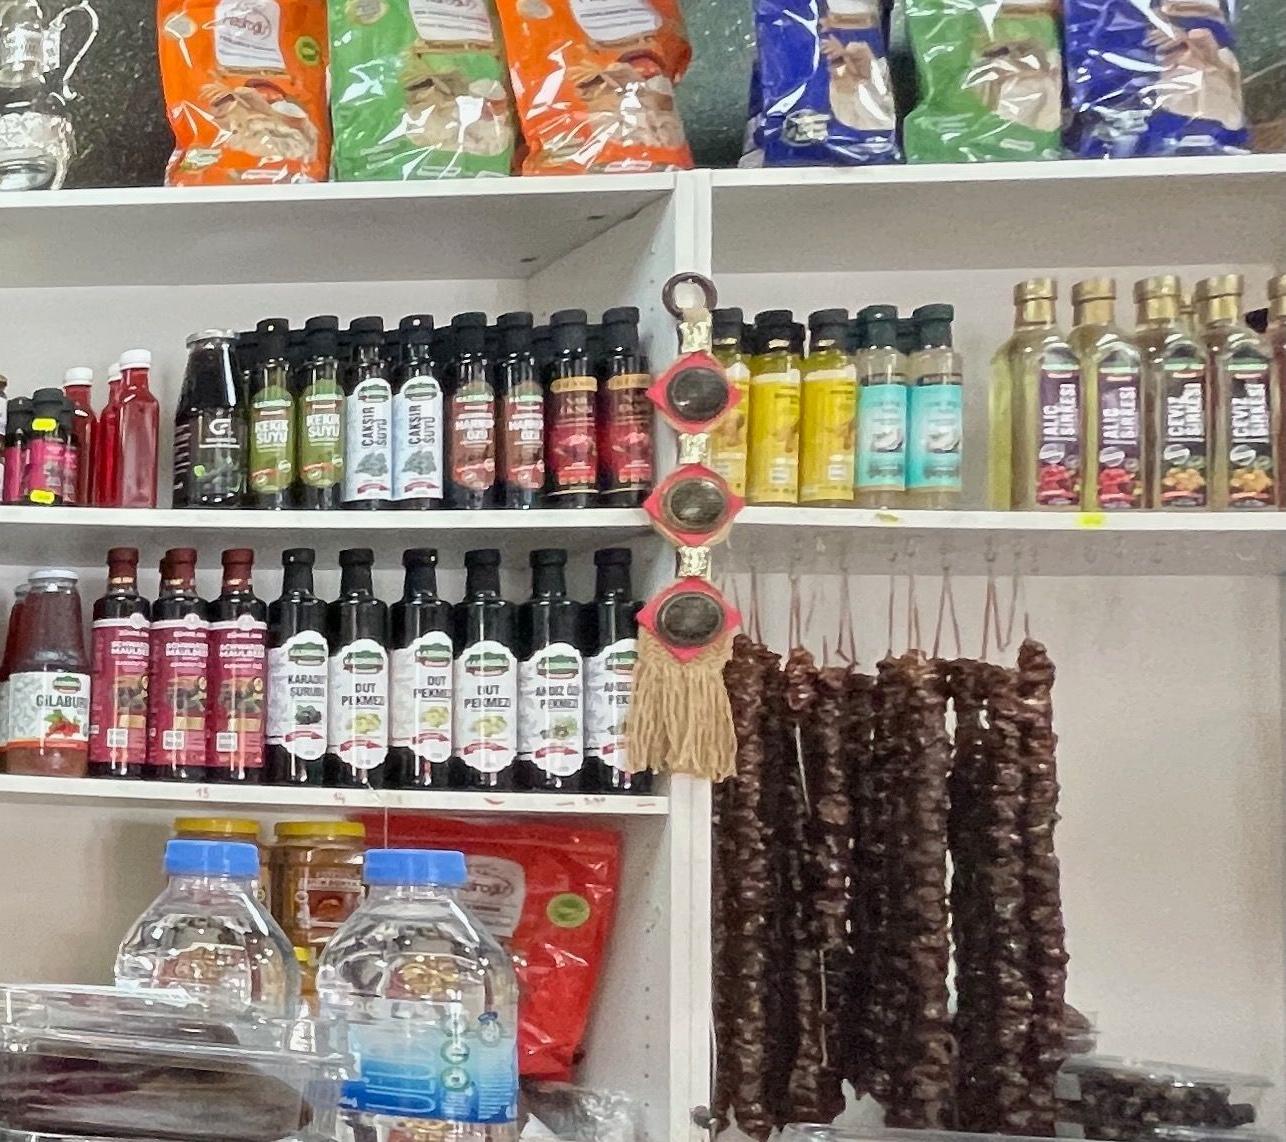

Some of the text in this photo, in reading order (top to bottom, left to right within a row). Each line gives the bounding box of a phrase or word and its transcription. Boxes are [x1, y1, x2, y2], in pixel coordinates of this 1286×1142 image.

[427, 675, 447, 686] DUT
[355, 683, 376, 693] DUT
[477, 685, 500, 696] DUT
